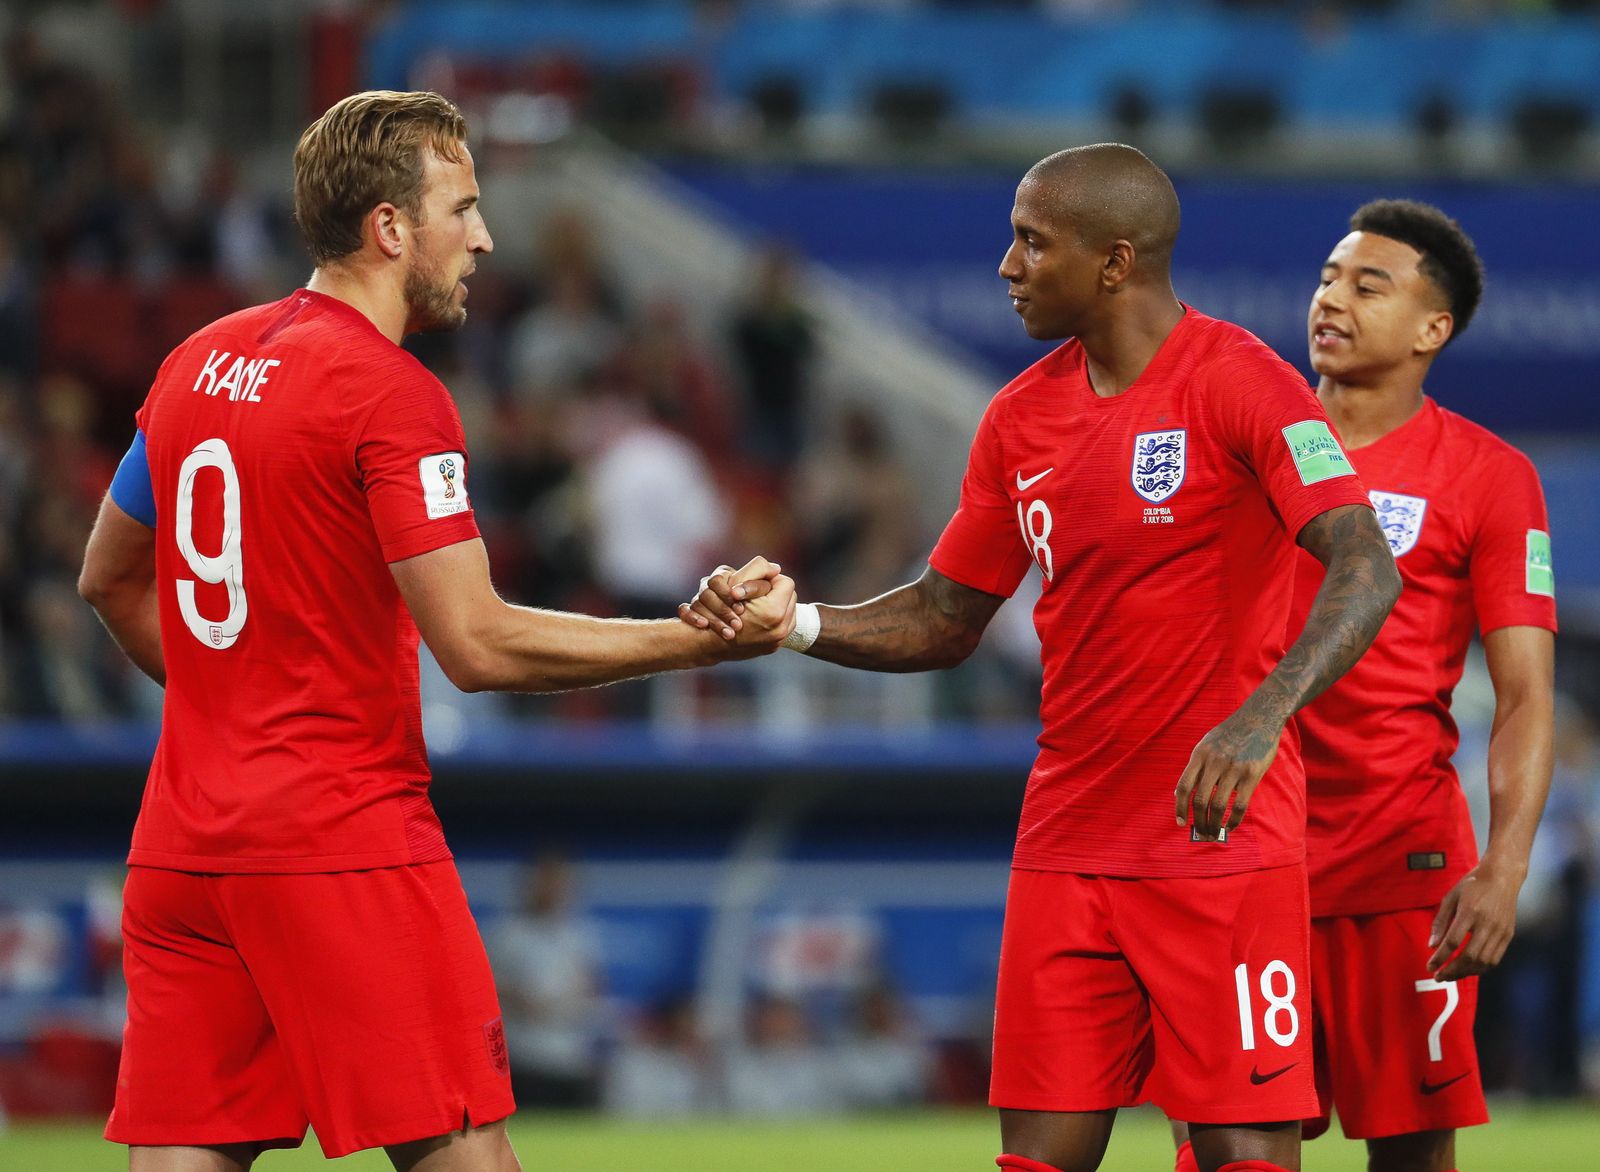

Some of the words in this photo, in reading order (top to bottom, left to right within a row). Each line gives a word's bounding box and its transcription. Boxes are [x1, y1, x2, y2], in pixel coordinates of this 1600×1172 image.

[193, 349, 280, 403] KANE
[1295, 436, 1335, 451] LIVING
[1329, 454, 1344, 462] FIFA
[1142, 516, 1147, 524] 3
[1148, 516, 1160, 524] JULY
[1161, 515, 1174, 523] 2018
[1143, 507, 1172, 516] COLOMBIA
[175, 438, 248, 650] 9
[1016, 499, 1054, 583] 18
[1234, 959, 1299, 1050] 18
[1414, 978, 1460, 1062] 7
